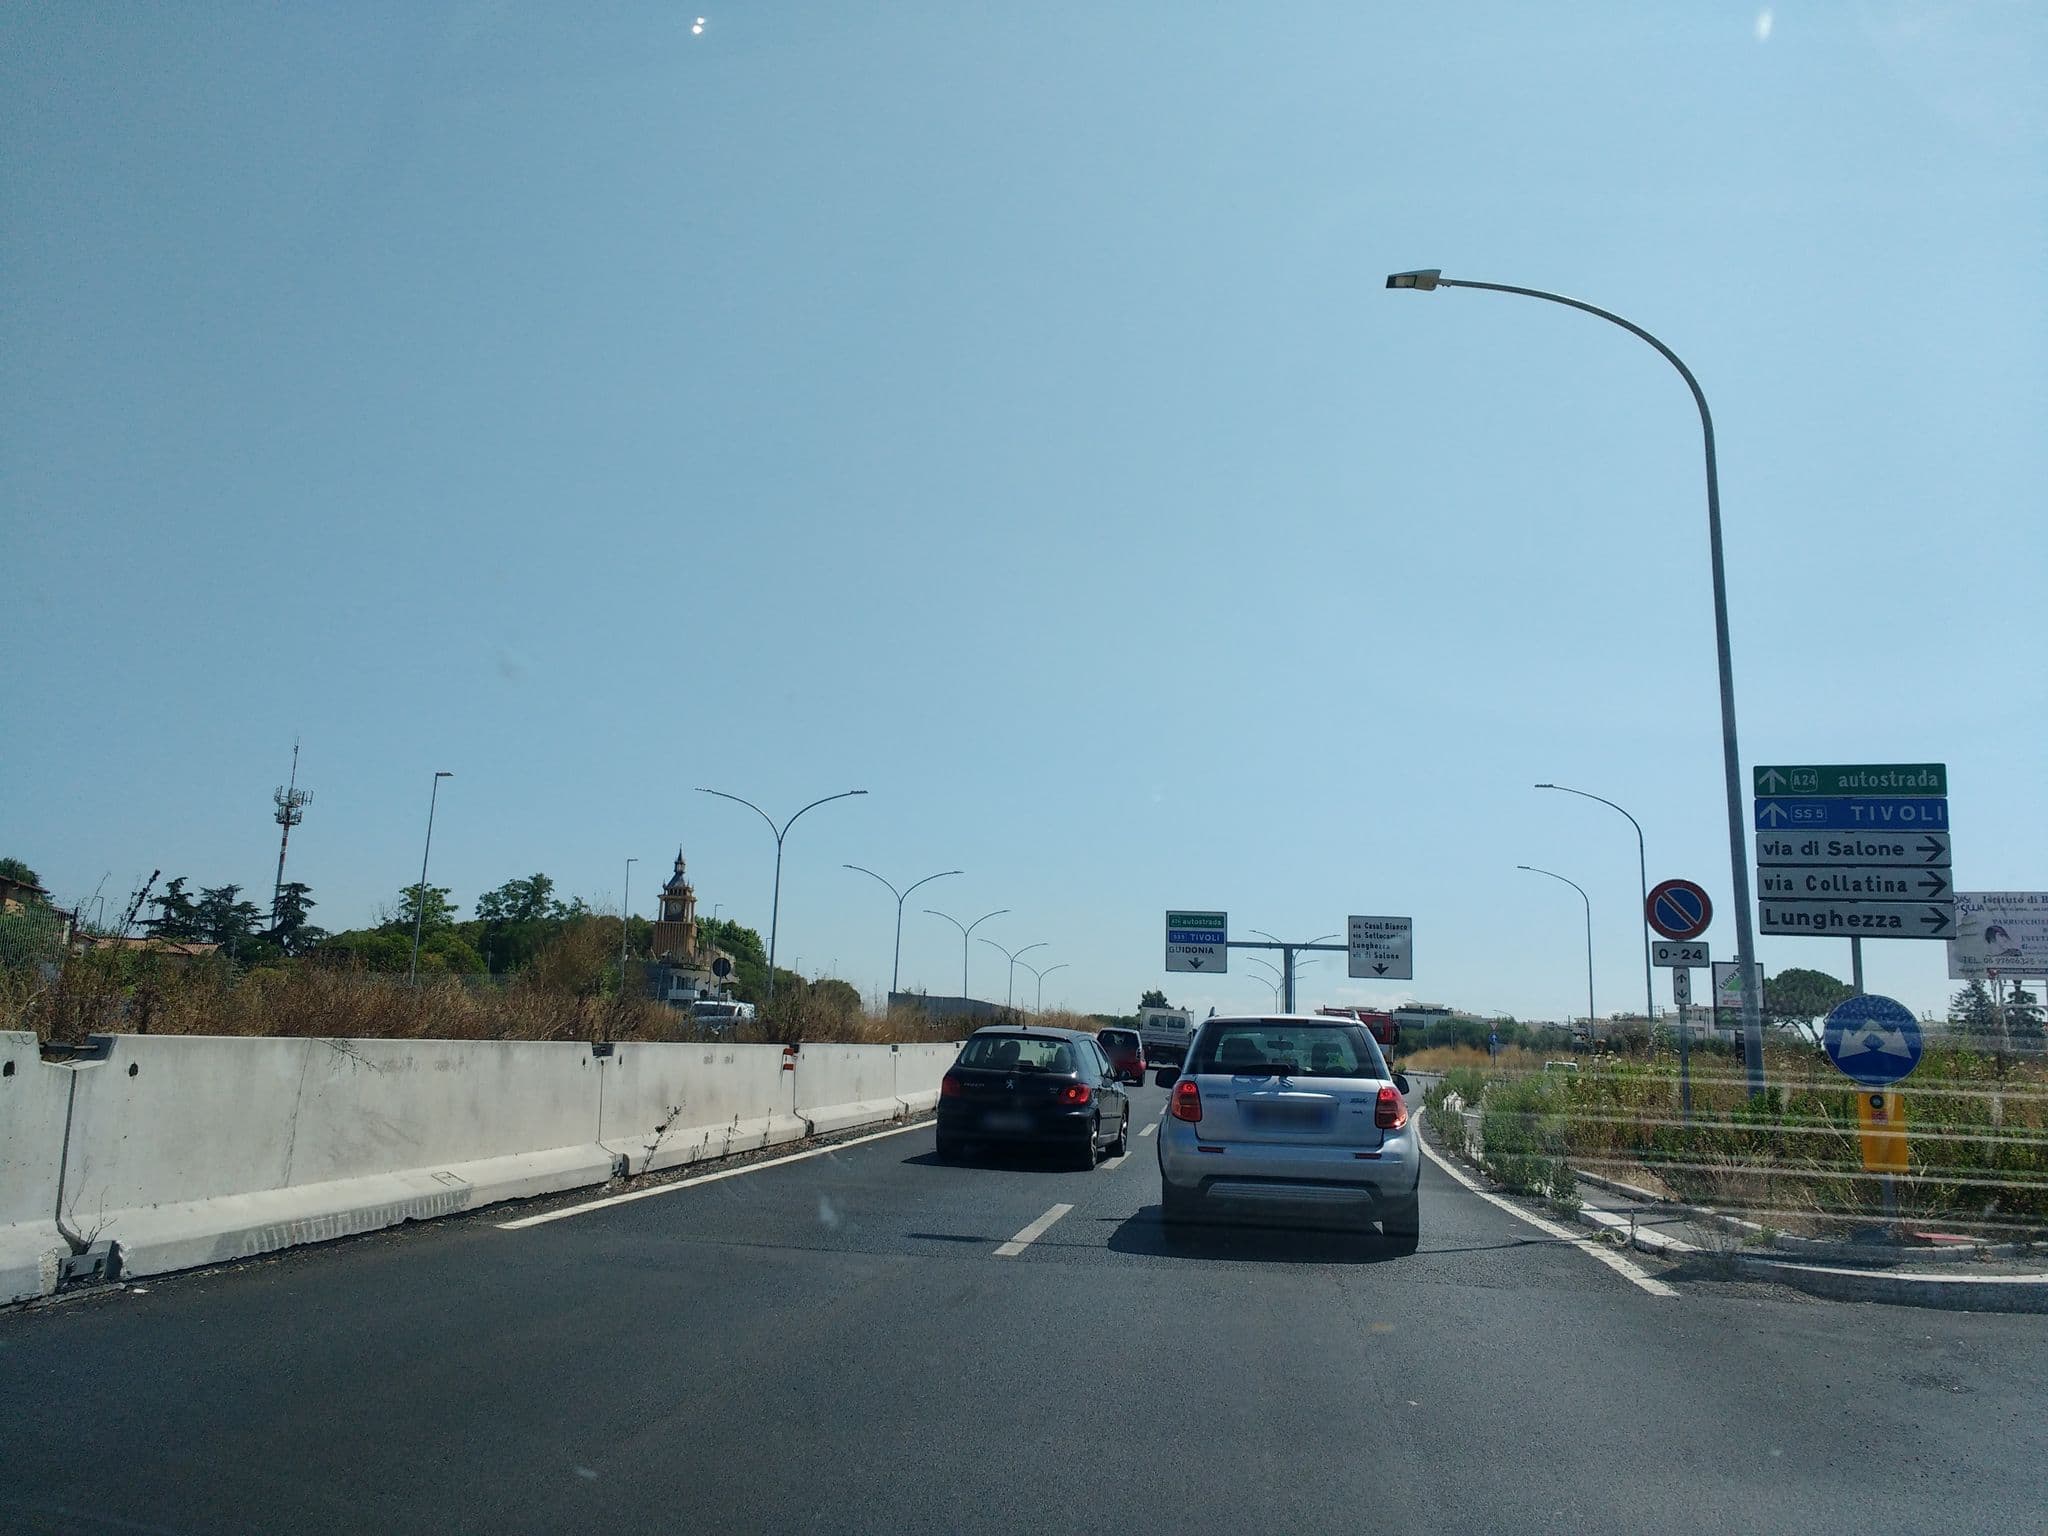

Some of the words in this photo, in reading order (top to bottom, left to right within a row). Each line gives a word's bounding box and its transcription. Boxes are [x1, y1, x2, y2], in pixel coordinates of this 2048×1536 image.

[1793, 773, 1816, 787] A24
[1838, 769, 1939, 788] autostrada
[1850, 805, 1943, 821] TIVOLI
[1763, 841, 1793, 856] via
[1801, 840, 1819, 856] di
[1828, 840, 1905, 856] Salone
[1764, 874, 1794, 892] via
[1806, 874, 1908, 893] Collatina
[1766, 908, 1903, 930] Lunghezza
[1364, 922, 1383, 930] Casal
[1385, 923, 1408, 931] Bianco
[1189, 933, 1220, 941] TIVOLI
[1168, 945, 1214, 954] GUIDONIA
[1352, 941, 1391, 951] Lunghezza
[1374, 951, 1400, 960] Salone
